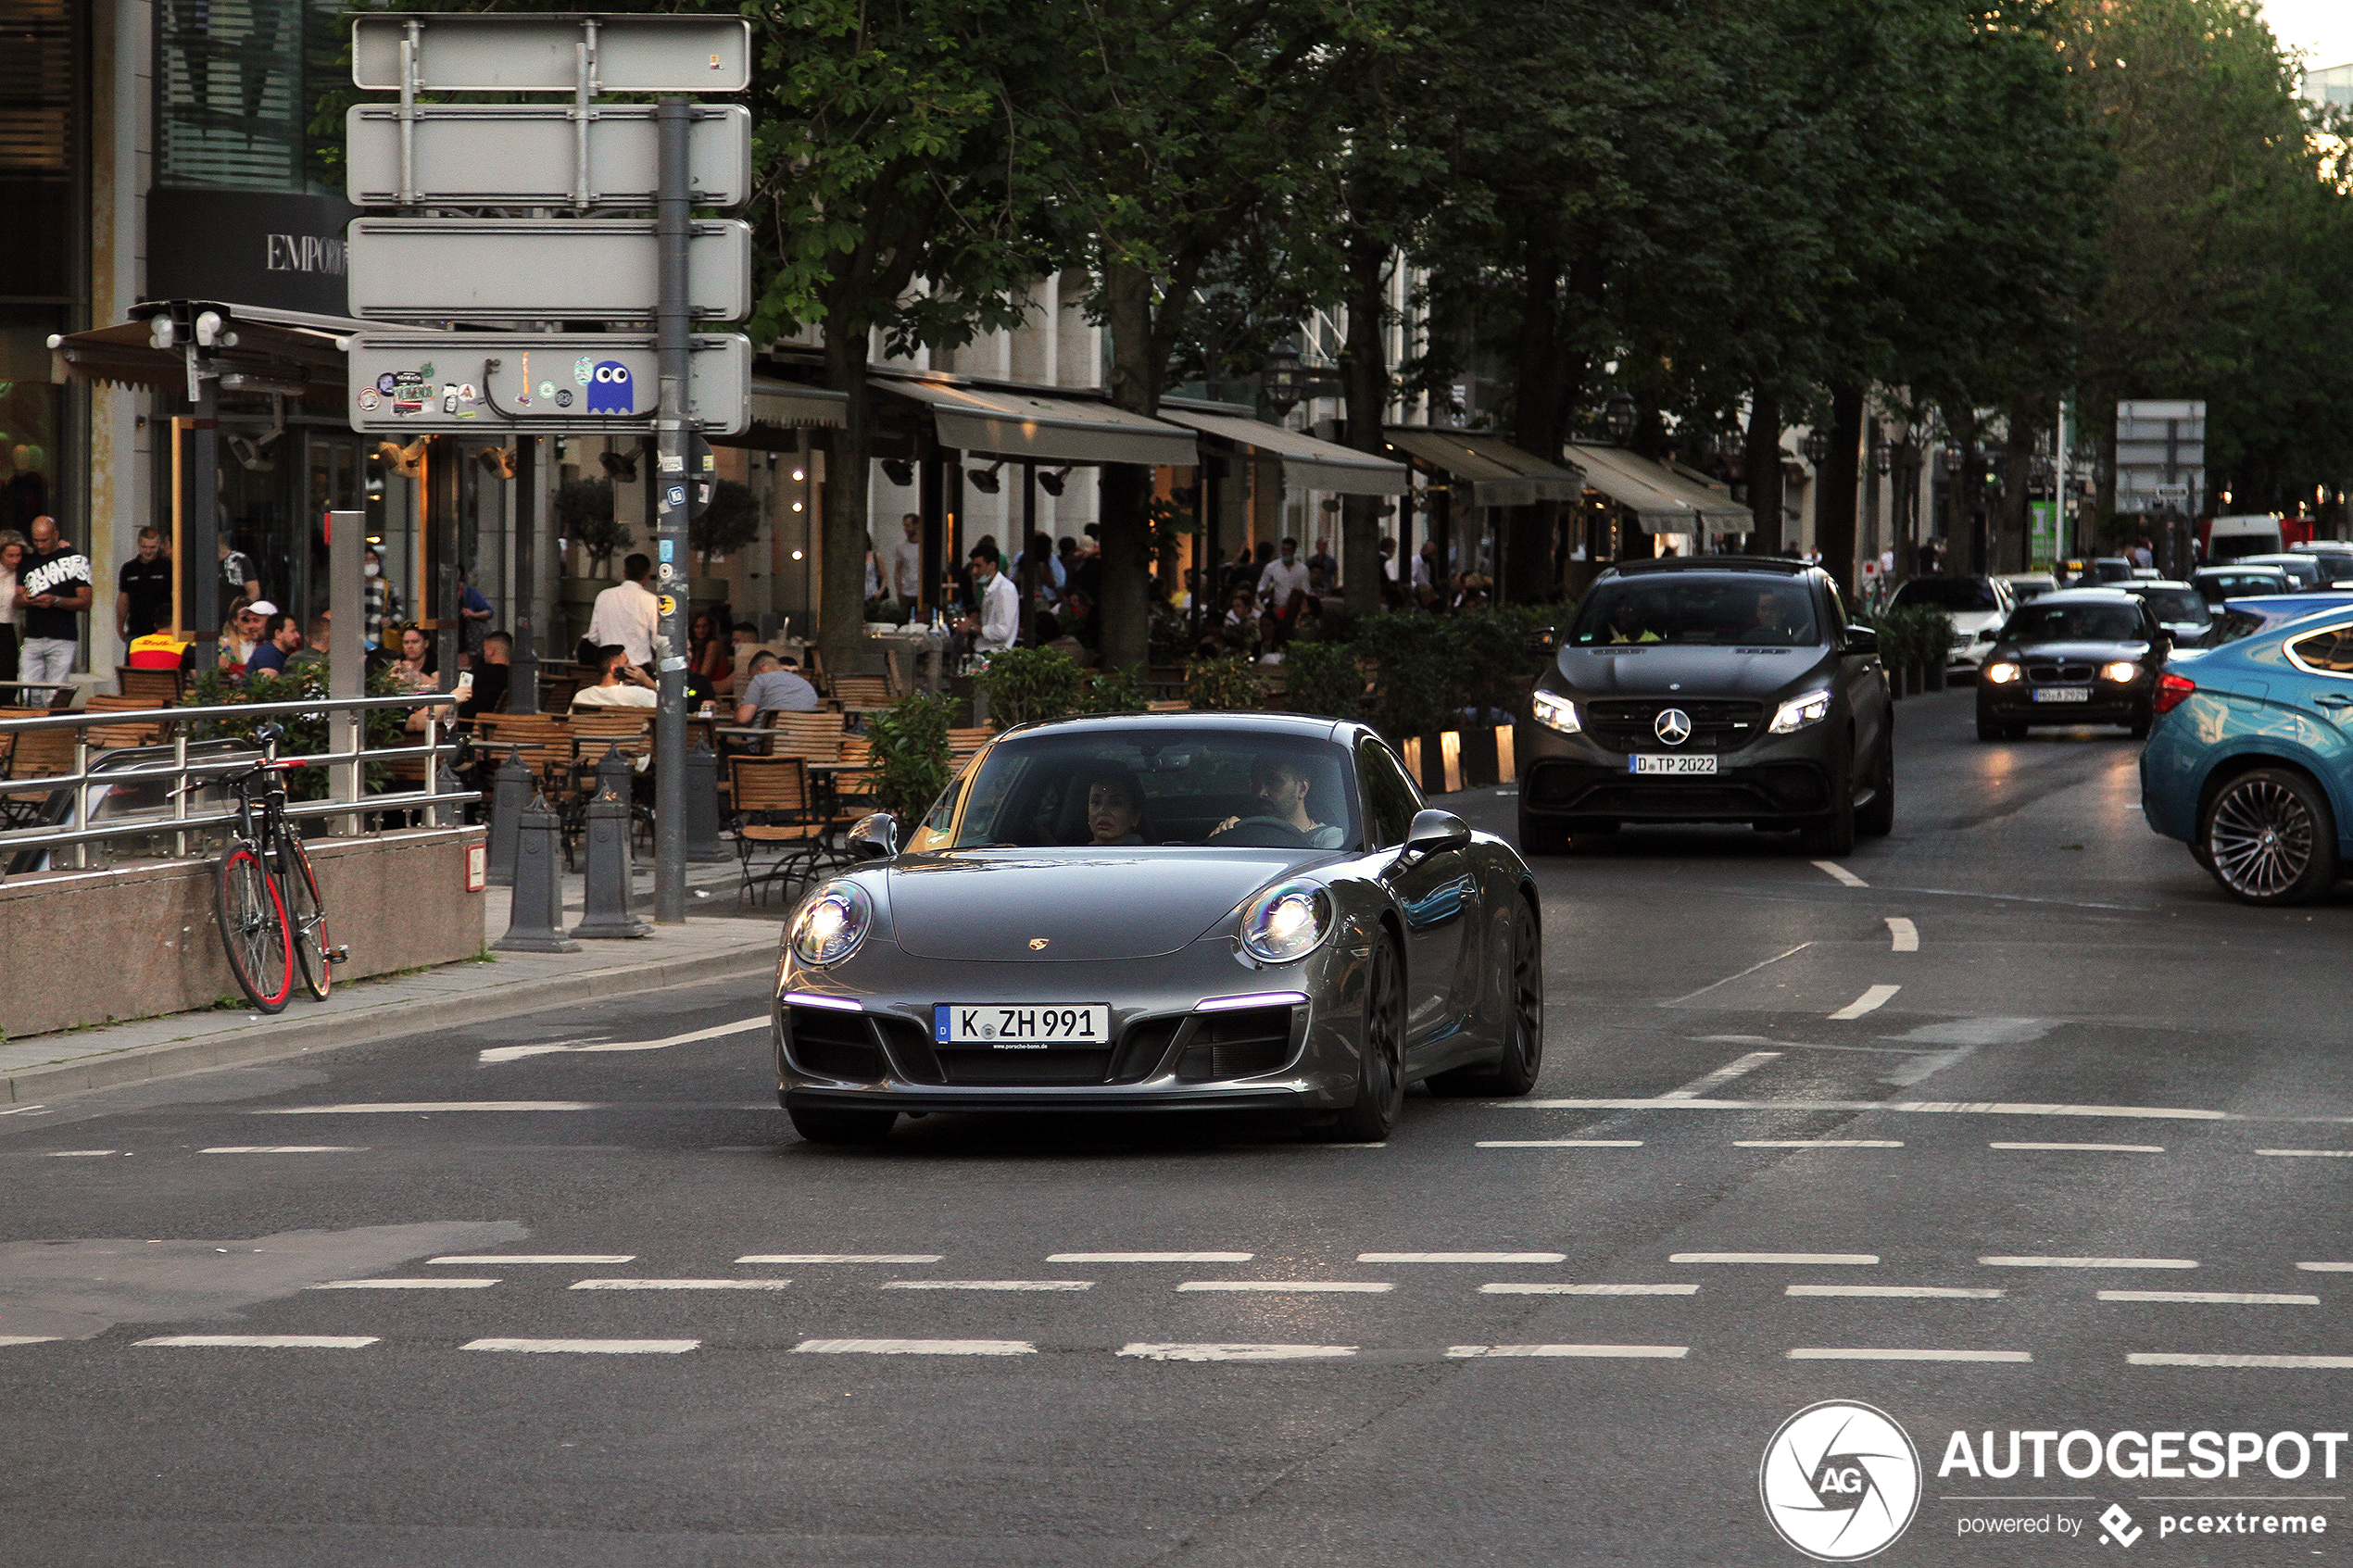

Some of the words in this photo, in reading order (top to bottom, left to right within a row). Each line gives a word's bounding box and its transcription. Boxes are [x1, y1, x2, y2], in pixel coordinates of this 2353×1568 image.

[1638, 758, 1647, 771] D
[1657, 758, 1675, 771] TP
[1679, 758, 1715, 771] 2022
[962, 1010, 979, 1036] K
[999, 1010, 1036, 1036] ZH
[1042, 1010, 1095, 1036] 991
[939, 1026, 947, 1035] D
